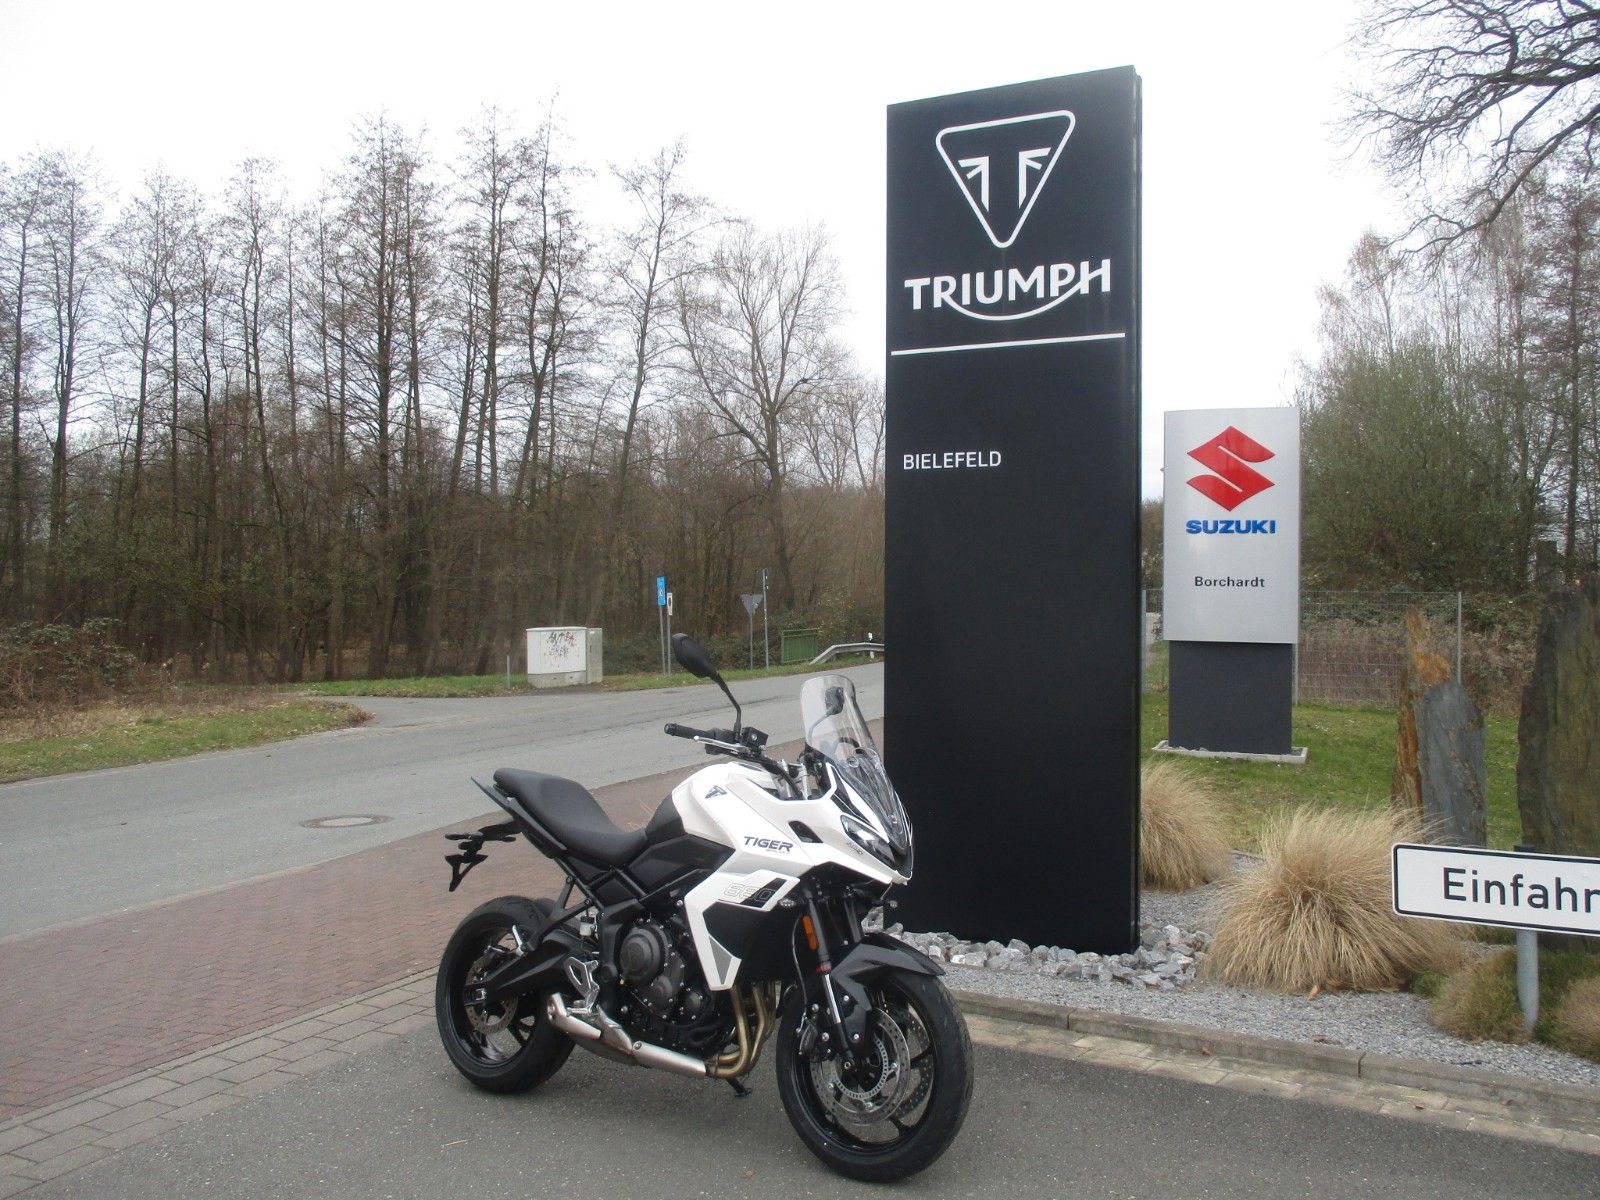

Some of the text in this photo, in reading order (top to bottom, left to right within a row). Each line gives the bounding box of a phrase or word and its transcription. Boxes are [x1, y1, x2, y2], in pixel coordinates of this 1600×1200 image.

[904, 258, 1111, 321] TRIUMPH
[903, 450, 1002, 470] BIELEFELD
[1186, 519, 1276, 534] SUZUKI
[1194, 575, 1265, 588] Borchardt
[744, 836, 794, 852] TIGER
[1443, 867, 1600, 913] Einfahr
